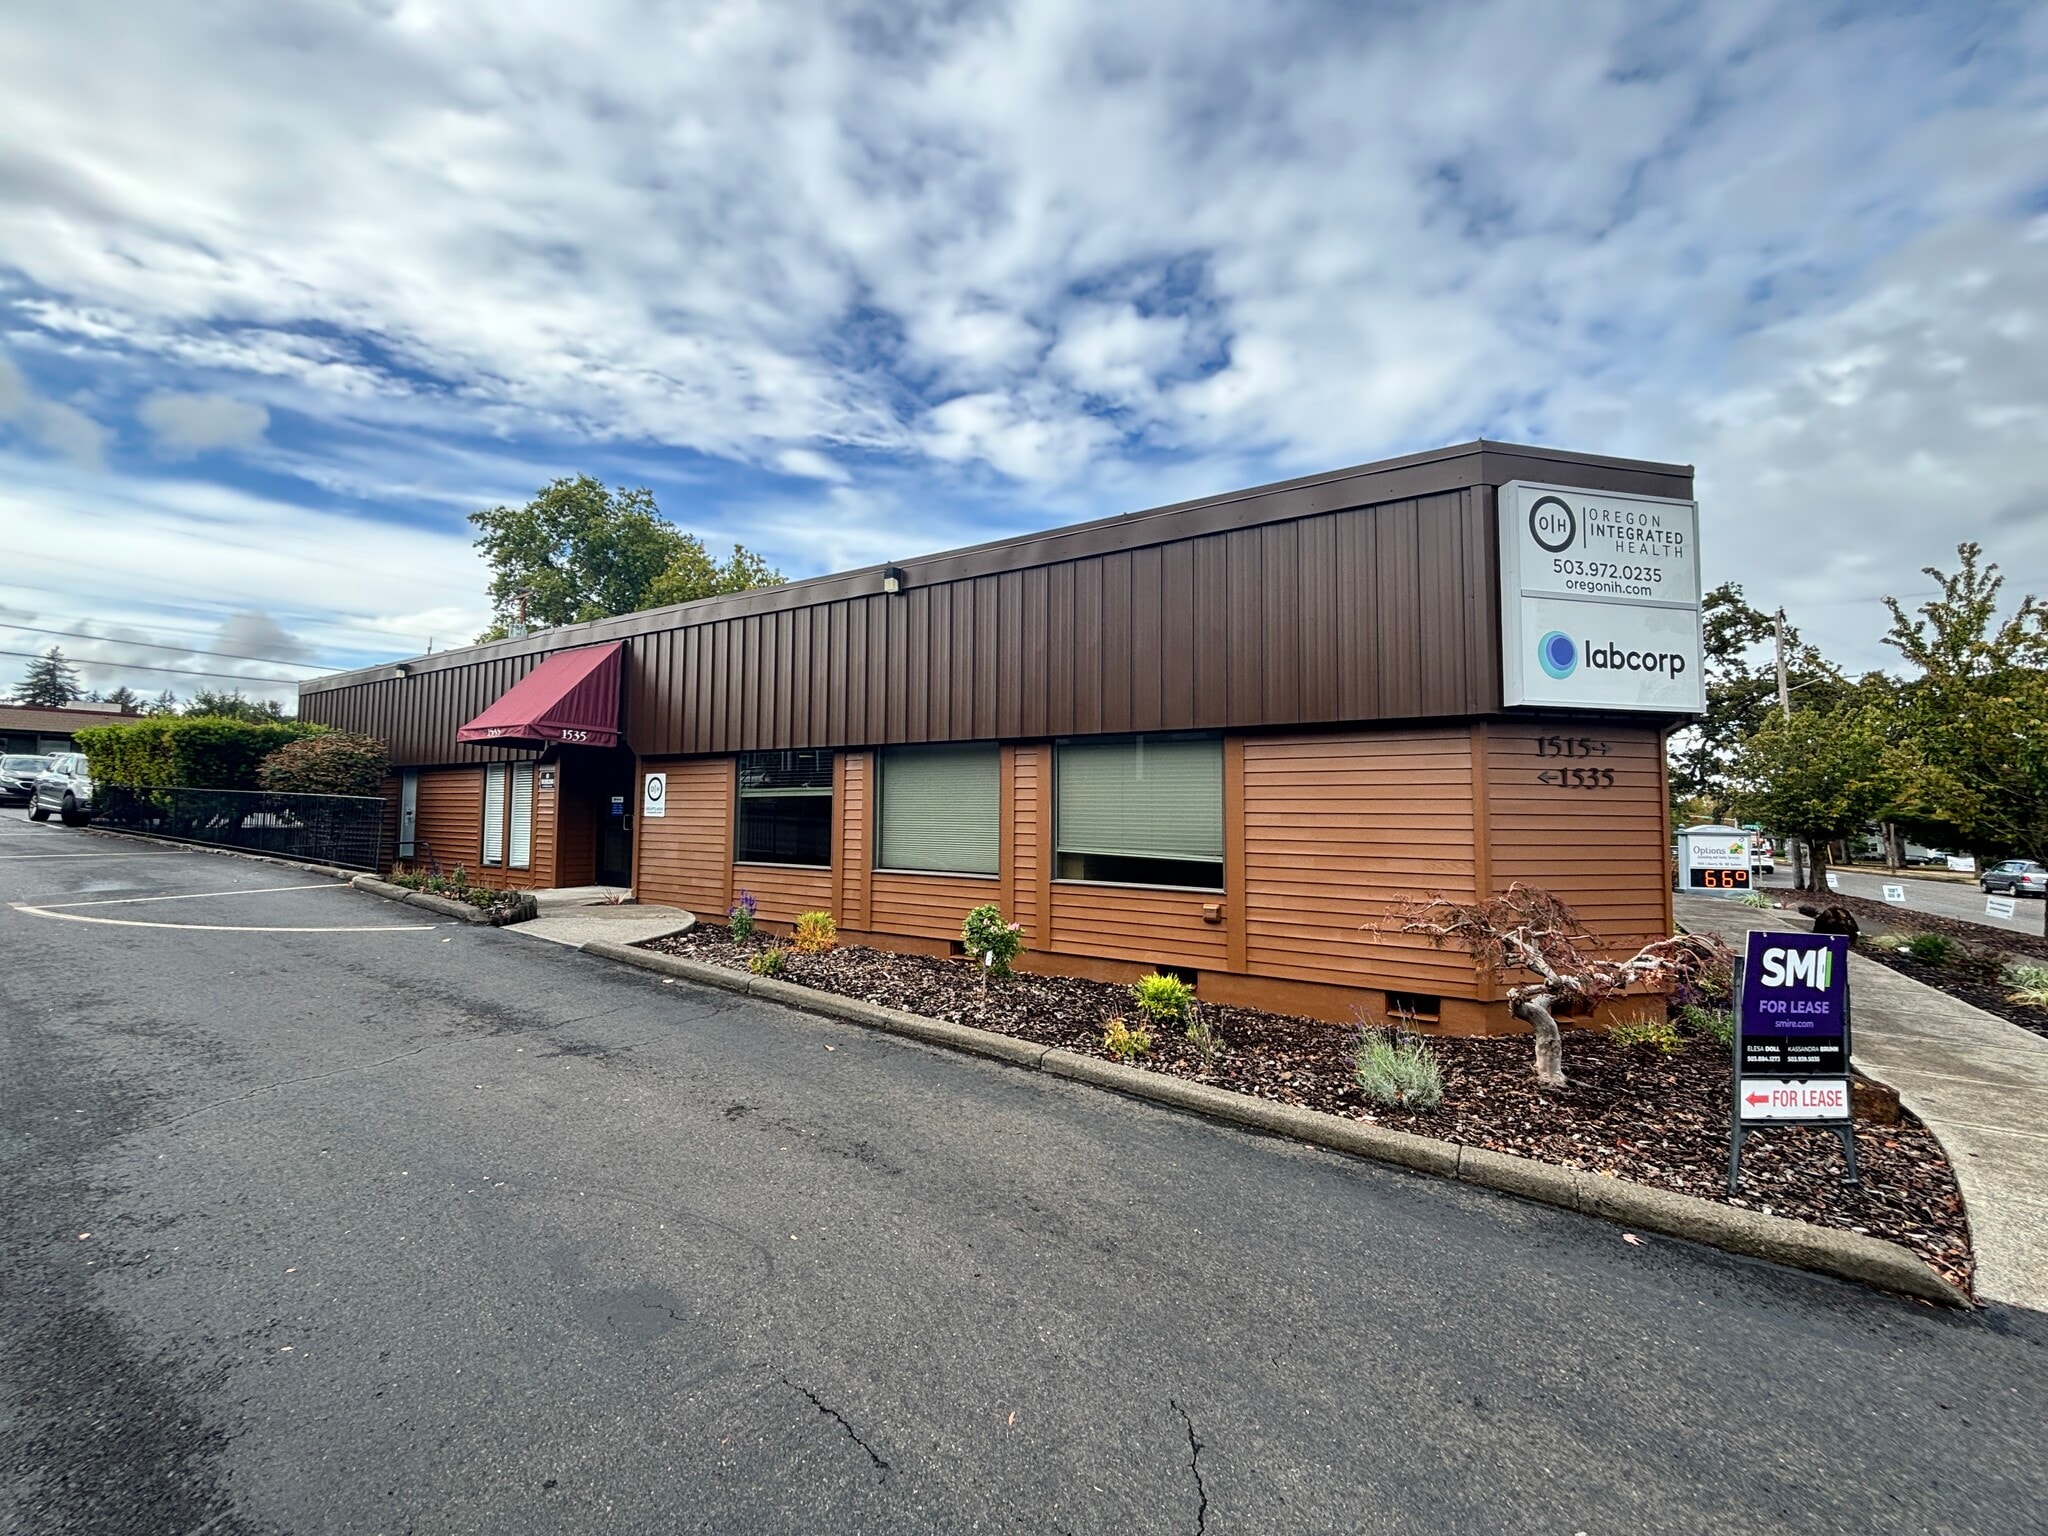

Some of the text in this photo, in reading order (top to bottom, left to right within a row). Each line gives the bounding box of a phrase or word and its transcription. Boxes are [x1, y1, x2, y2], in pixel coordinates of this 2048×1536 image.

[1589, 508, 1661, 527] OREGON
[1590, 523, 1683, 545] INTEGRATED
[1615, 541, 1684, 558] HEALTH
[1553, 558, 1662, 583] 503.972.0235
[1565, 579, 1652, 596] oregonih.com
[1585, 640, 1686, 680] labcorp
[561, 729, 587, 742] 1535
[1534, 735, 1592, 759] 1515
[1558, 767, 1615, 790] 1535
[1693, 845, 1727, 856] Options
[1759, 1000, 1830, 1014] FOR LEASE
[1775, 1019, 1814, 1028] smire.com
[1772, 1090, 1843, 1107] FOR LEASE
